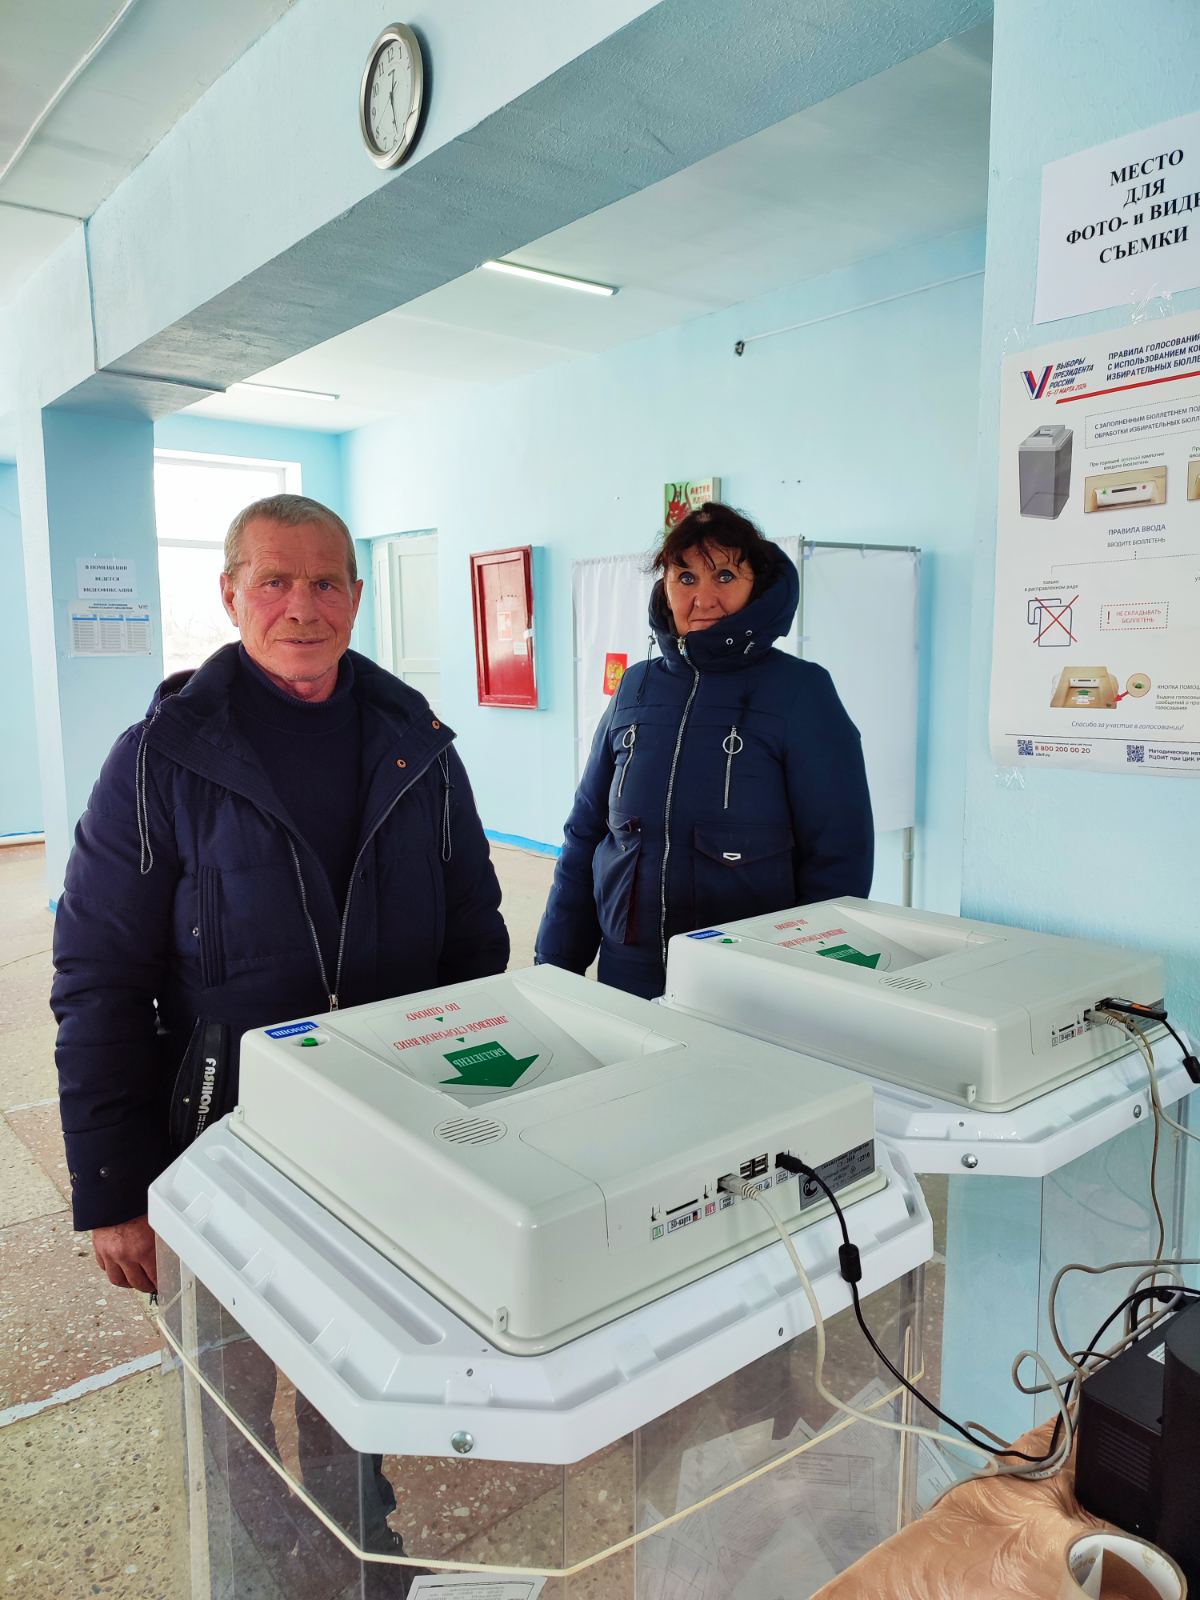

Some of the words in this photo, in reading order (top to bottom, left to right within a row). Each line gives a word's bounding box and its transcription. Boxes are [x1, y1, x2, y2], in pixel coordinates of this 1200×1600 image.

[386, 46, 394, 63] 12
[378, 62, 384, 77] 11
[372, 82, 380, 98] 10
[372, 106, 376, 120] 9
[1110, 149, 1184, 186] МЕСТО
[1123, 178, 1166, 209] ДЛЯ
[1066, 217, 1128, 244] ФОТО-
[1134, 212, 1144, 226] и
[1100, 225, 1189, 264] СЪЕМКИ
[1108, 346, 1144, 360] ПРАВИЛА
[1114, 347, 1186, 370] ИСПОЛЬЗОВАНИЕМ
[1188, 344, 1200, 354] КО
[1052, 364, 1094, 380] ПРЕЗИДЕНТА
[1056, 357, 1086, 371] ВЫБОРЫ
[1106, 361, 1172, 381] ИЗБИРАТЕЛЬНЫХ
[1049, 377, 1076, 390] РОССИИ
[1099, 415, 1146, 430] ЗАПОЛНЕННЫМ
[1146, 408, 1188, 420] БЮЛЛЕТЕНЕМ
[1094, 428, 1129, 440] ОБРАБОТКИ
[1129, 420, 1181, 433] ИЗБИРАТЕЛЬНЫХ
[1108, 526, 1140, 536] ПРАВИЛА
[1142, 524, 1166, 532] ВВОДА
[406, 1006, 444, 1022] ОДНОМУ
[444, 1002, 461, 1012] ПО
[270, 1024, 315, 1036] ПОМОЩЬ
[466, 1015, 509, 1032] ЛИЦЕВОЙ
[393, 1038, 420, 1050] ВНИЗ
[419, 1026, 468, 1046] СТОРОНОЙ
[452, 1047, 507, 1068] БЮЛЛЕТЕНЬ
